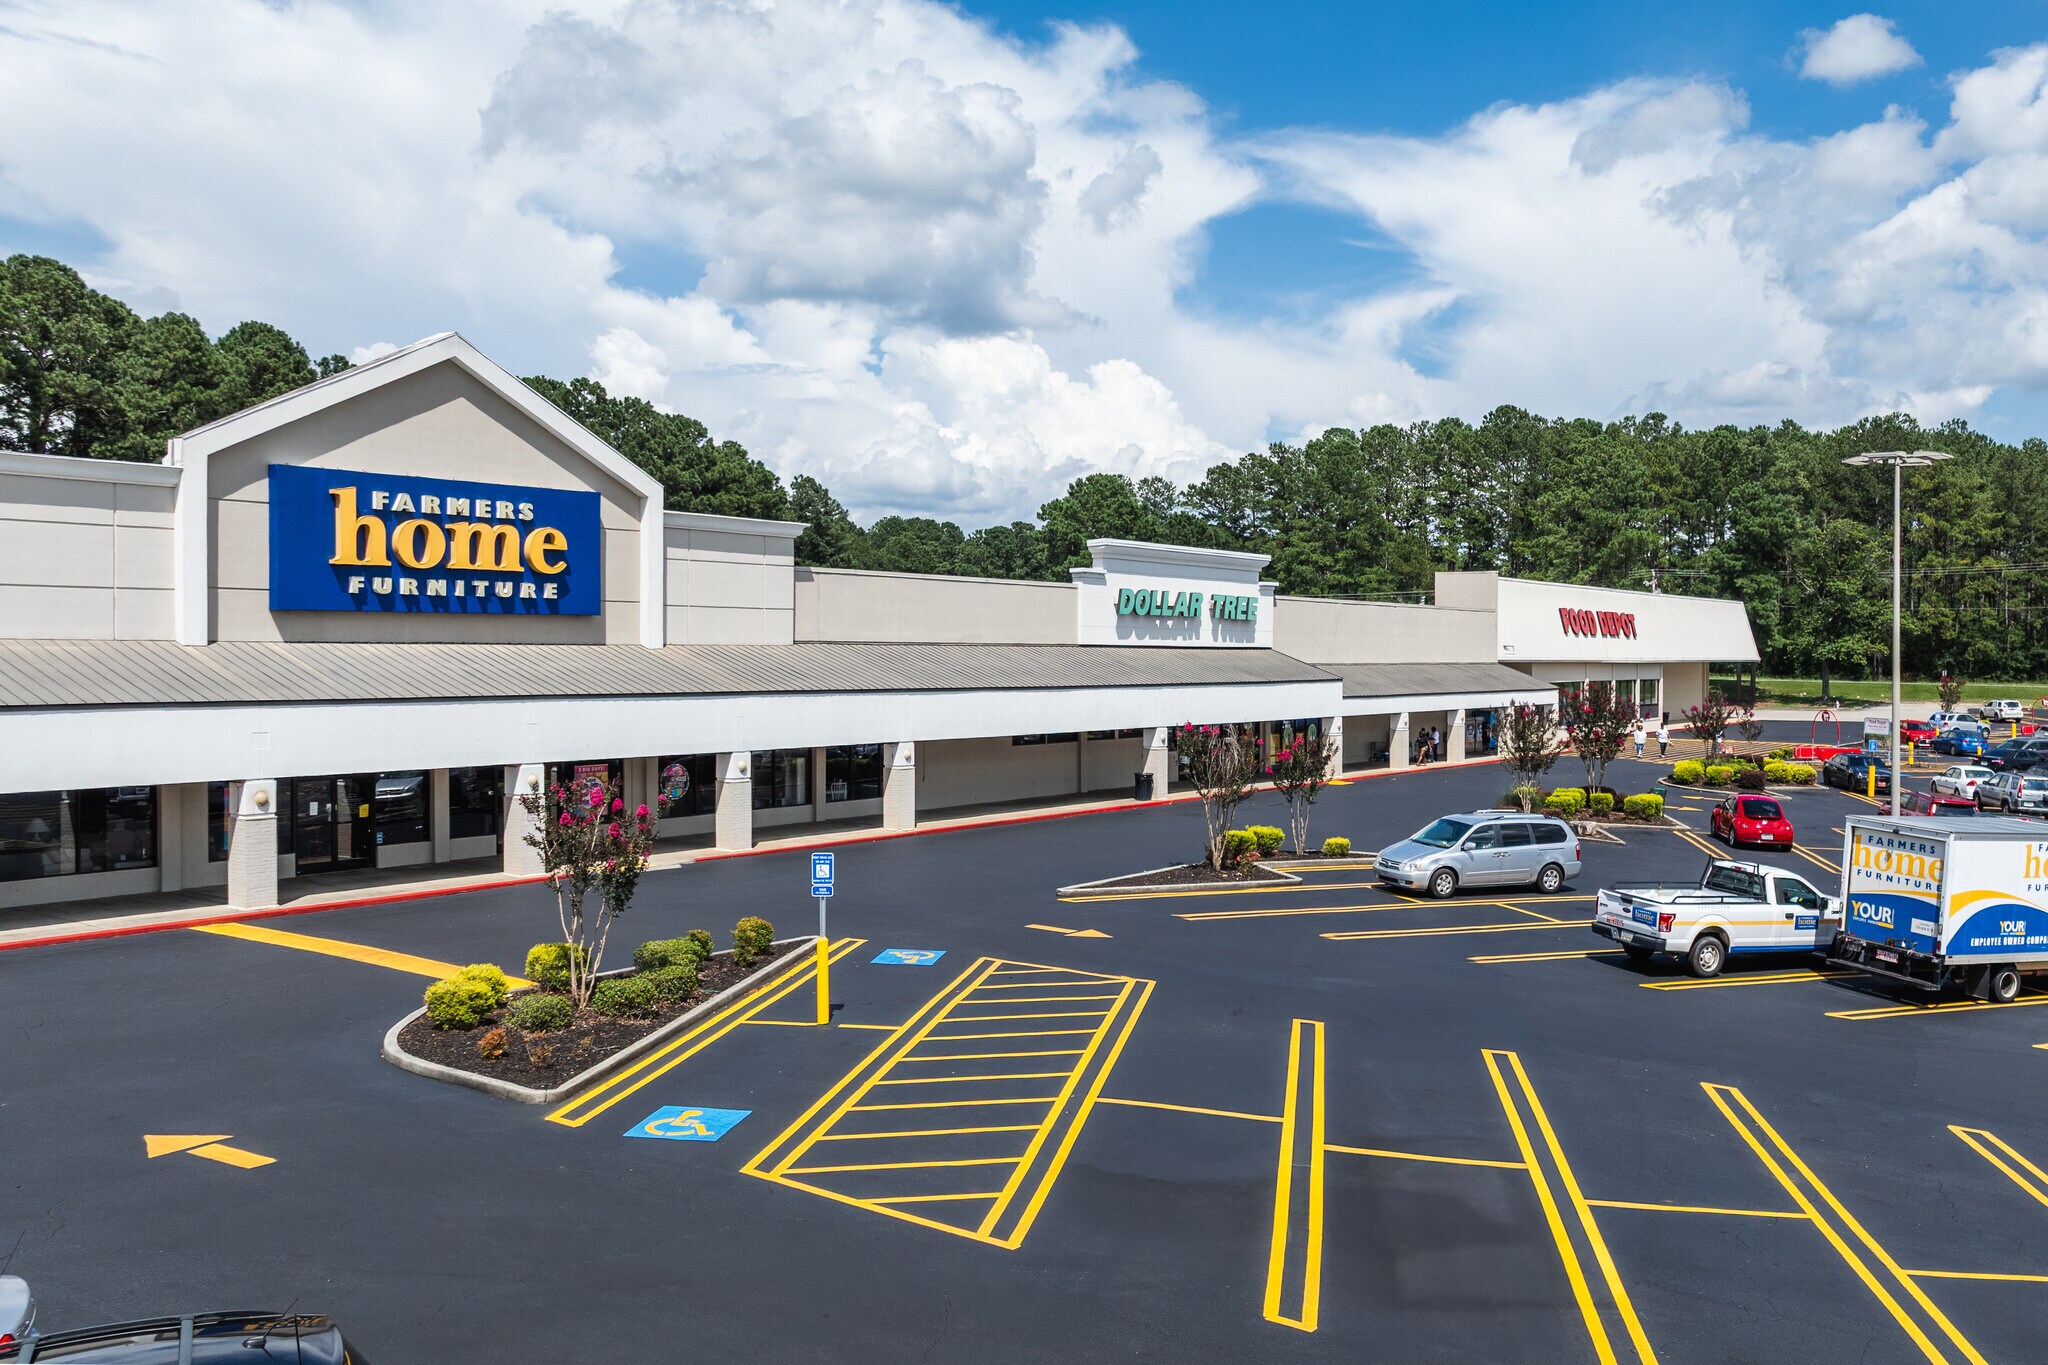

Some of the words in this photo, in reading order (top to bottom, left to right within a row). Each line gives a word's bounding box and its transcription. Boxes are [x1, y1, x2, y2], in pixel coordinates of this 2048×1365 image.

[371, 490, 535, 521] FARMERS
[328, 485, 568, 575] home
[348, 576, 558, 600] FURNITURE
[1118, 588, 1204, 618] DOLLAR
[1210, 594, 1259, 621] TREE
[1559, 608, 1598, 636] FOOD
[1596, 611, 1638, 640] DEPOT
[1868, 835, 1936, 854] FARMERS
[1852, 834, 1945, 883] home
[1857, 869, 1942, 892] FURNITURE
[1797, 916, 1816, 925] home
[1851, 900, 1892, 923] YOUR
[2000, 920, 2025, 933] YOUR
[1970, 937, 2002, 947] EMPLOYEE
[2003, 936, 2025, 946] OWNED
